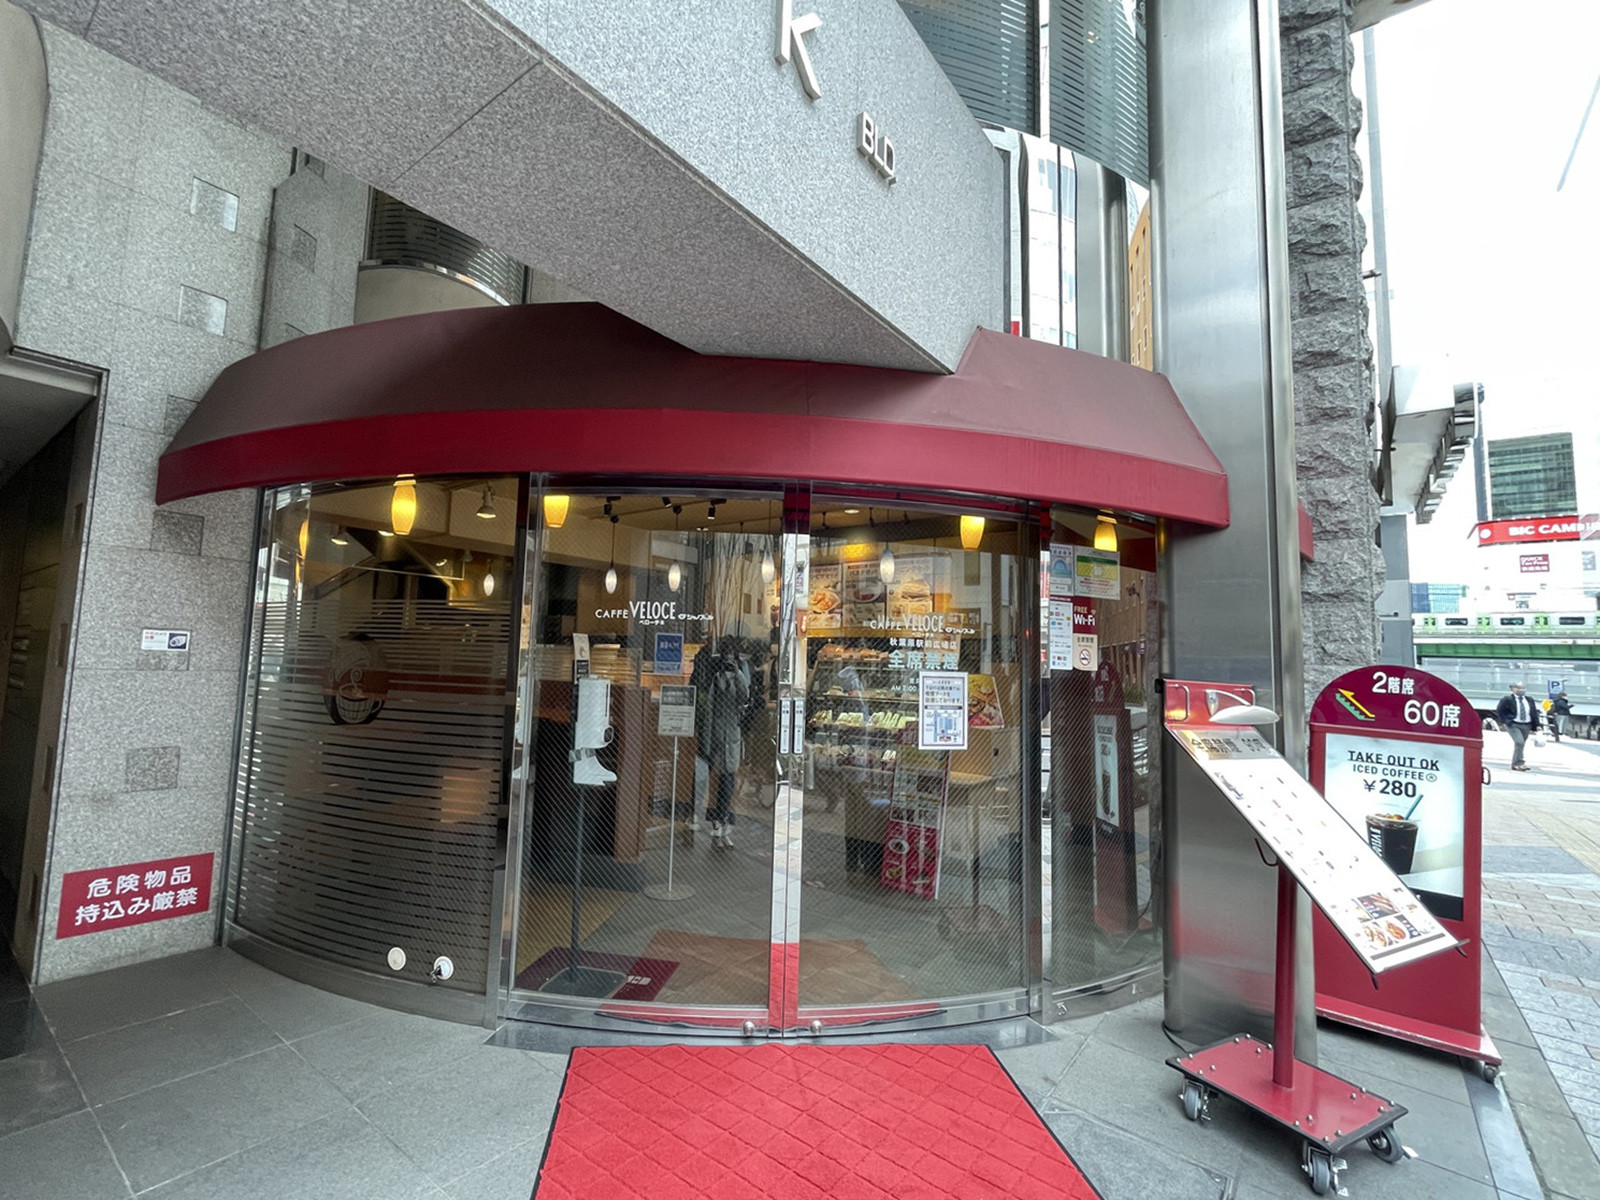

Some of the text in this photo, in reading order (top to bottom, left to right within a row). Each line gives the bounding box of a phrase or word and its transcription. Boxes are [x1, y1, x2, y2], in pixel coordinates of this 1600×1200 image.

[1509, 526, 1535, 536] BIC
[629, 601, 676, 620] VELOCE
[1074, 605, 1088, 614] FREE
[903, 613, 944, 633] VELOCE
[1073, 613, 1096, 626] Wi-Fi
[888, 650, 959, 670] 全席禁煙
[1371, 671, 1415, 695] 2階席
[1551, 681, 1560, 689] P
[1404, 699, 1461, 728] 60席
[1347, 750, 1440, 771] TAKE OUT OK
[1353, 764, 1378, 775] ICED
[1382, 768, 1424, 781] COFFEE
[1363, 779, 1417, 798] ¥280
[86, 866, 192, 899] 危険物品
[74, 887, 199, 926] 持込み厳禁
